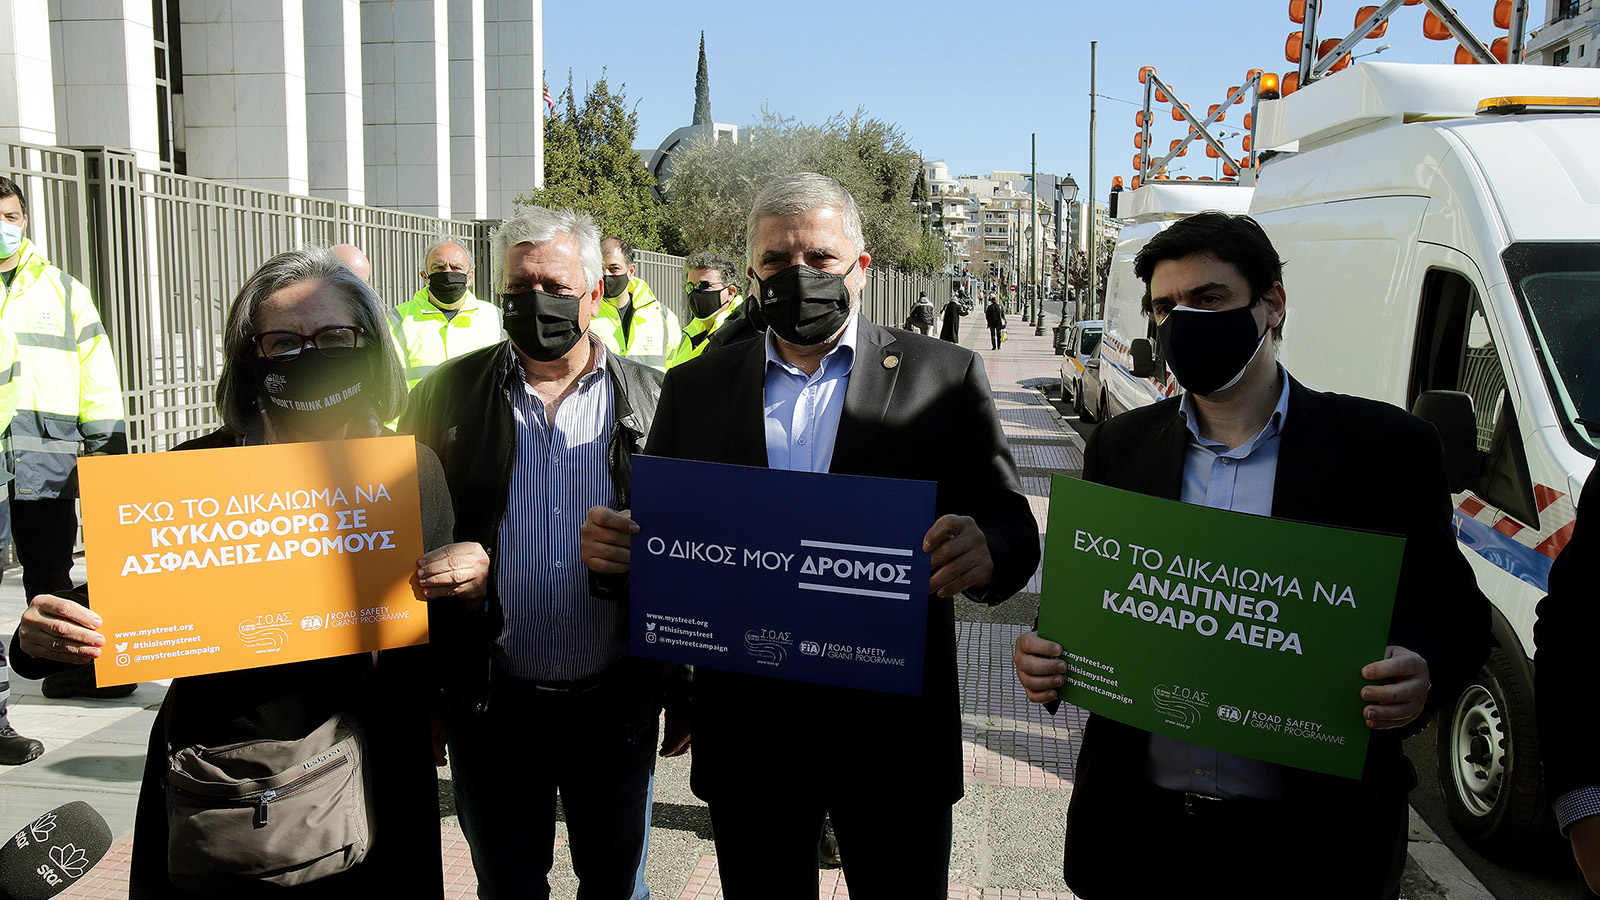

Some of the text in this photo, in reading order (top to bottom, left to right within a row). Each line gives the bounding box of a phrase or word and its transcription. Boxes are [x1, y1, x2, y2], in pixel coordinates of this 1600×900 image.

[295, 400, 322, 412] DRINK
[324, 393, 341, 407] AND
[342, 382, 362, 400] DRIVE
[118, 483, 391, 525] ΕΧΩ ΤΟ ΔΙΚΑΙΩΜΑ ΝΑ
[151, 509, 367, 548] ΚΥΚΛΟΦΟΡΩ ΣΕ
[121, 530, 396, 576] ΑΣΦΑΛΕΙΣ ΔΡΟΜΟΥΣ
[647, 536, 912, 584] Ο ΔΙΚΟΣ ΜΟΥ ΔΡΟΜΟΣ
[1074, 530, 1356, 608] ΕΧΩ ΤΟ ΔΙΚΑΙΩΜΑ ΝΑ
[1128, 572, 1280, 623] ΑΝΑΠΝΕΩ
[331, 606, 390, 620] ROAD SAFETY
[332, 610, 410, 628] GRANT PROGRAMME
[646, 613, 708, 628] www.mystreet.org
[1102, 590, 1303, 655] ΚΑΘΑΡΟ ΑΕΡΑ
[114, 624, 194, 638] www.mystreet.org
[660, 626, 714, 639] #thisismystreet
[133, 634, 201, 649] #thisismystreet
[659, 636, 728, 652] @mystreetcampaign
[828, 644, 886, 656] ROAD SAFETY
[134, 646, 220, 662] @mystreetcampaign
[828, 651, 906, 666] GRANT PROGRAMME
[1252, 710, 1322, 732] ROAD SAFETY
[1250, 720, 1345, 745] GRANT PROGRAMME
[14, 831, 30, 850] star
[36, 864, 62, 886] star
